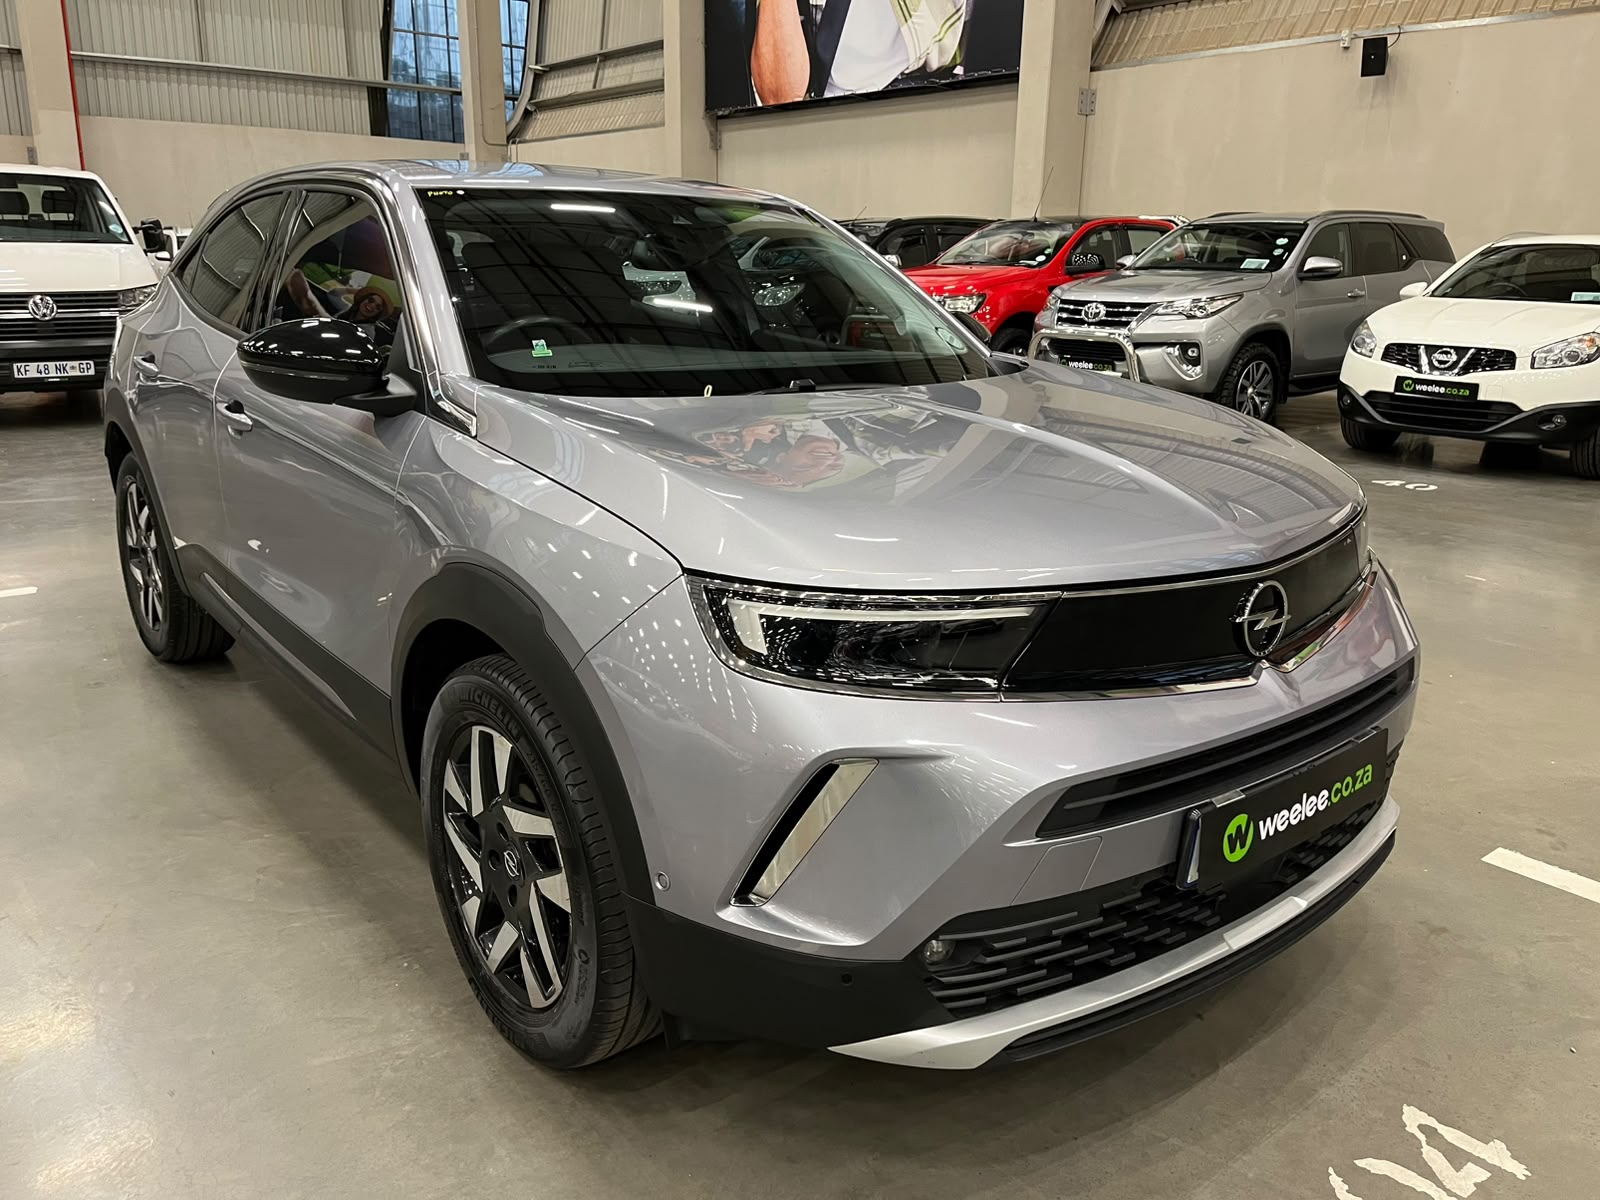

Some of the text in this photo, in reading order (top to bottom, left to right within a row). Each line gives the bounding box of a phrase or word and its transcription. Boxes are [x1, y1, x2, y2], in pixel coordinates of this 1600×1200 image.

[16, 362, 92, 377] KF 48 NK GP
[1415, 384, 1470, 396] weelee.co.za
[459, 687, 521, 742] MICHELIN
[1258, 764, 1373, 840] weelee.co.za
